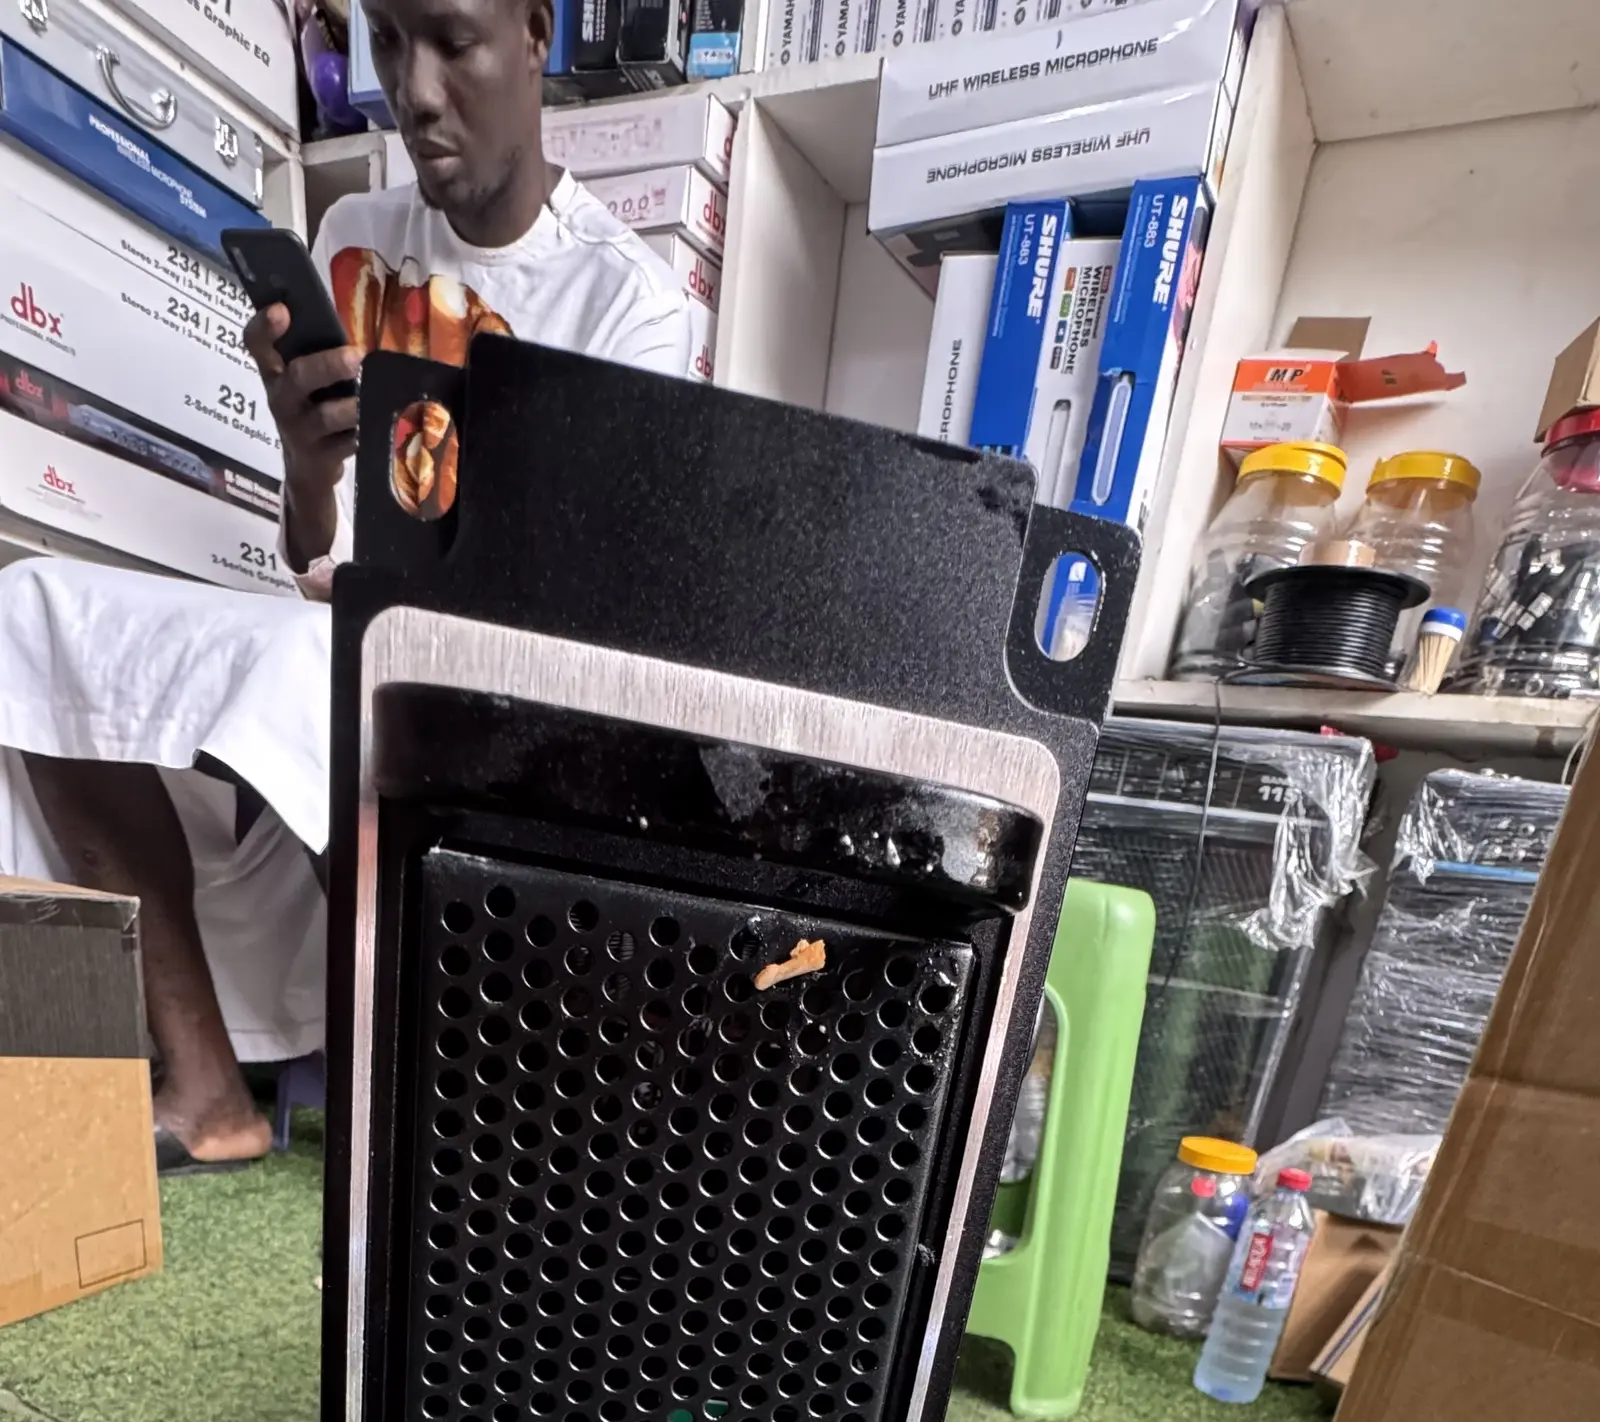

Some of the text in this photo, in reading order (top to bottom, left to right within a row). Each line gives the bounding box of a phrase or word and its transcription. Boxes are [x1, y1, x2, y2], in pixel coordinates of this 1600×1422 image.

[253, 44, 271, 67] EQ
[928, 37, 1159, 100] UHF WIRELESS MICROPHONE
[926, 127, 1151, 183] UHF WIRELESS MICROPHONE
[1017, 213, 1036, 265] UT-883
[1143, 194, 1165, 248] UT-883
[166, 245, 201, 279] 234
[1027, 213, 1058, 318] SHURE
[1152, 194, 1189, 305] SHURE
[687, 255, 714, 302] dbx
[10, 281, 63, 339] dbx
[166, 296, 201, 329] 234
[1064, 265, 1093, 376] MICROPHONE
[1079, 265, 1104, 348] WIRELESS
[184, 394, 229, 425] 2-Series
[231, 417, 272, 446] Graphic
[217, 384, 257, 421] 231
[43, 463, 76, 495] dbx
[239, 541, 277, 571] 231
